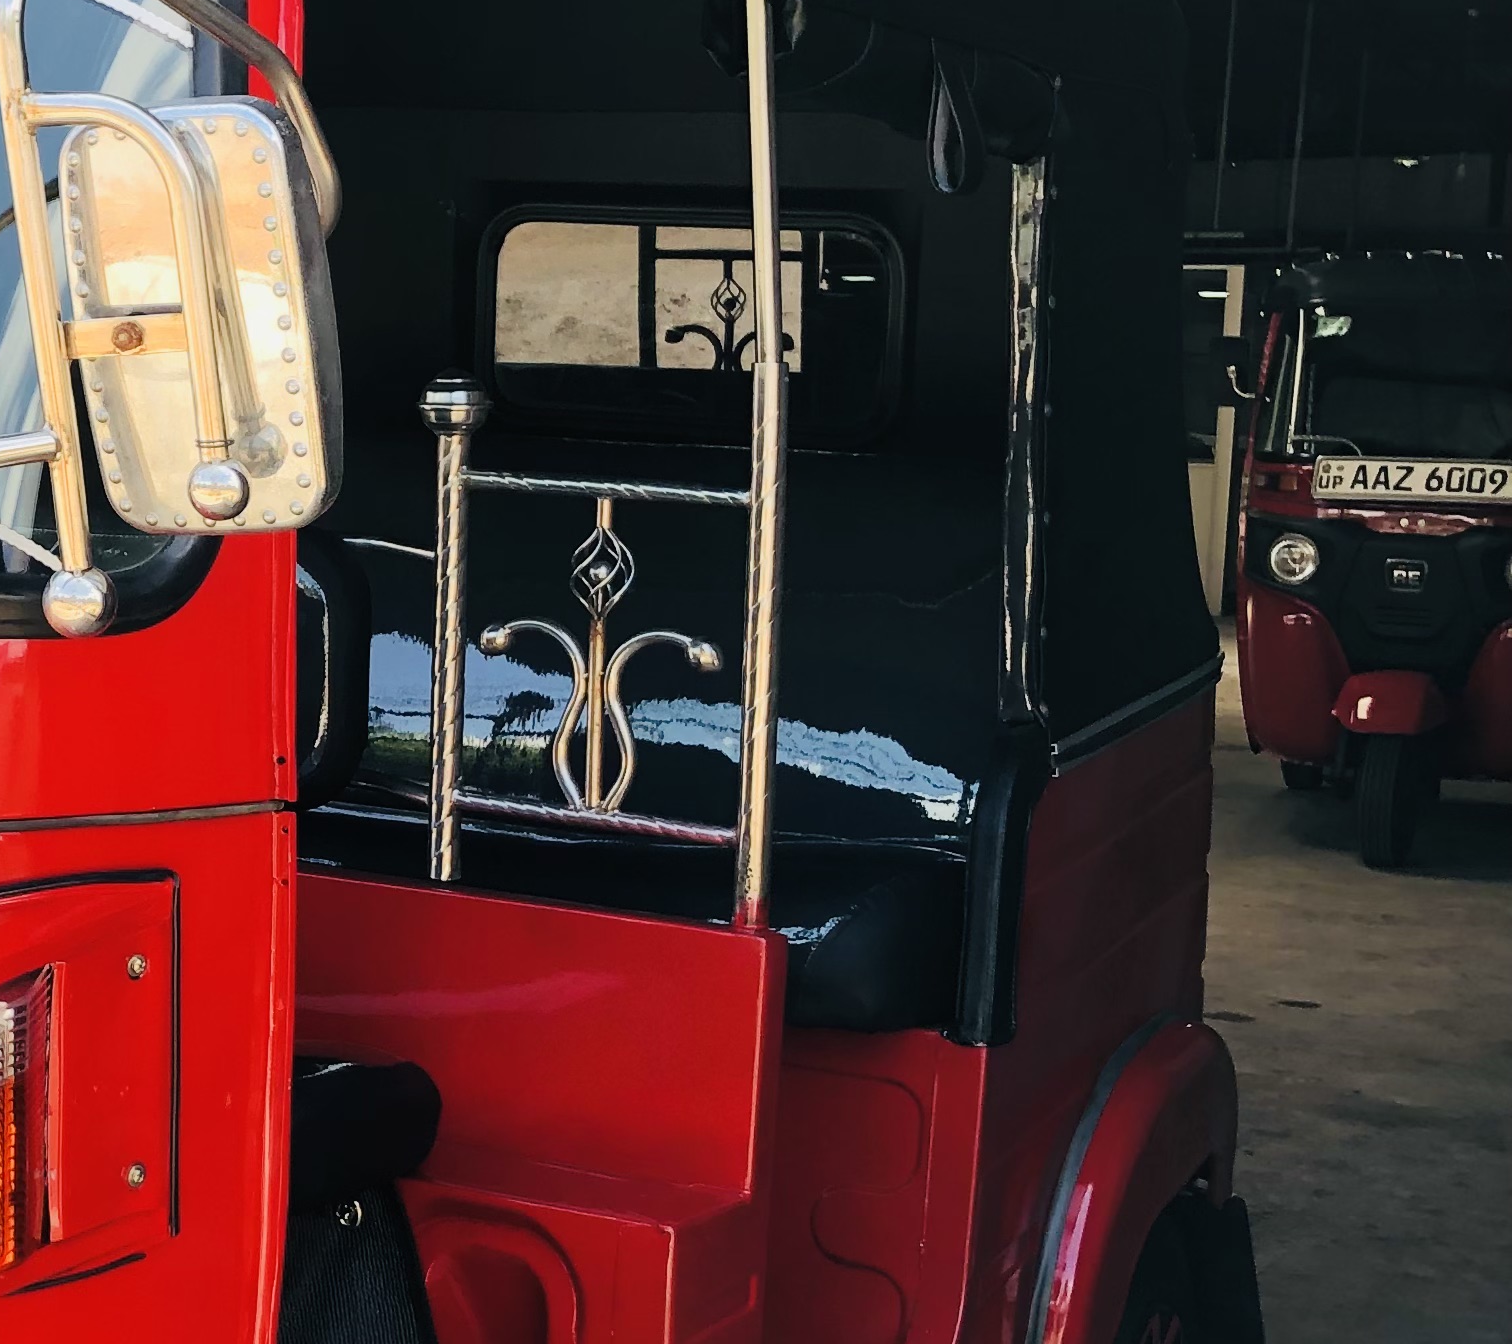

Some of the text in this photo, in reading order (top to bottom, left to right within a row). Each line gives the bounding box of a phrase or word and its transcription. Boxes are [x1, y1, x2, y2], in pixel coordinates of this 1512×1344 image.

[1318, 464, 1509, 495] UP AAZ 6009
